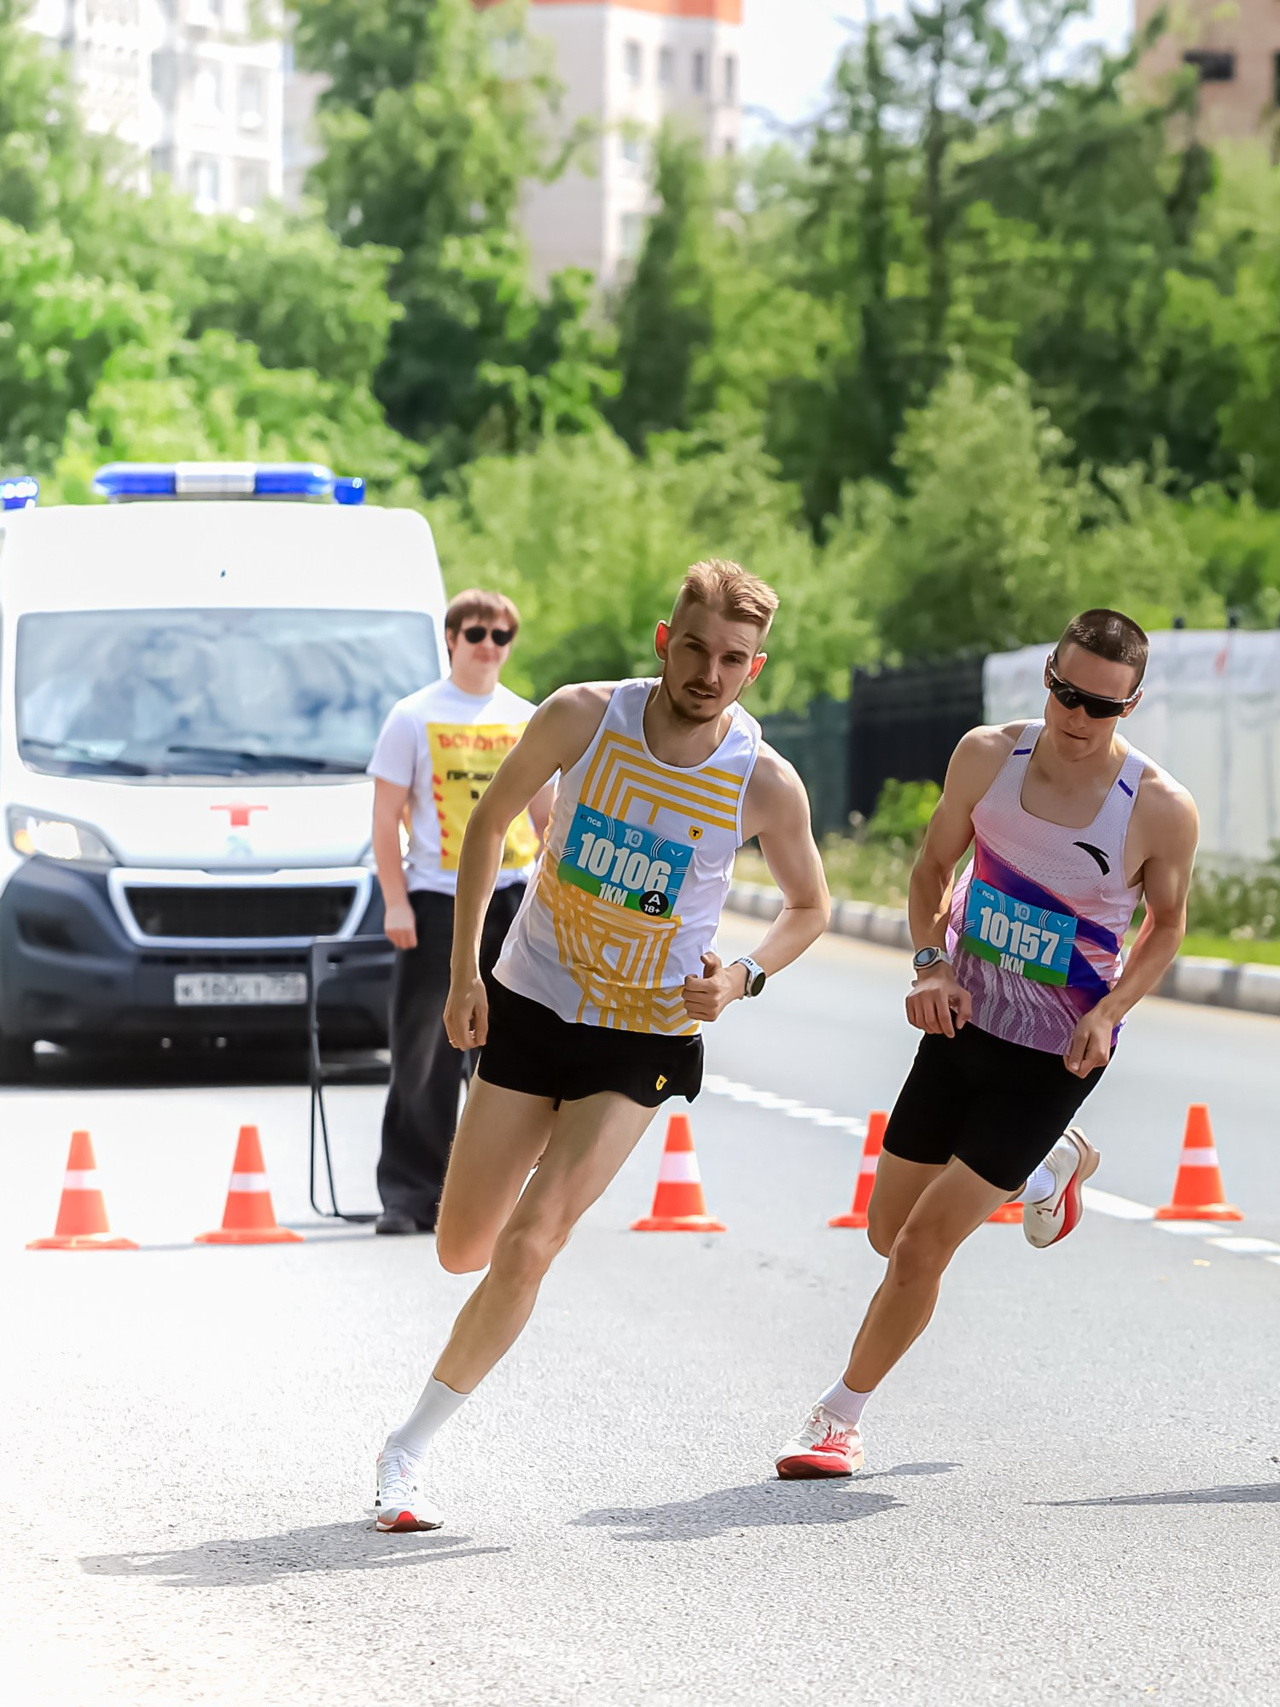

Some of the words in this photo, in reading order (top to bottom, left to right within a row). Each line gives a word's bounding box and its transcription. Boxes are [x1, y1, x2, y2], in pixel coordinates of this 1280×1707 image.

[577, 832, 672, 893] 10106
[598, 882, 629, 907] 1KM
[648, 894, 661, 906] A
[643, 904, 660, 914] 18+
[979, 906, 1060, 966] 10157
[999, 953, 1025, 976] 1KM
